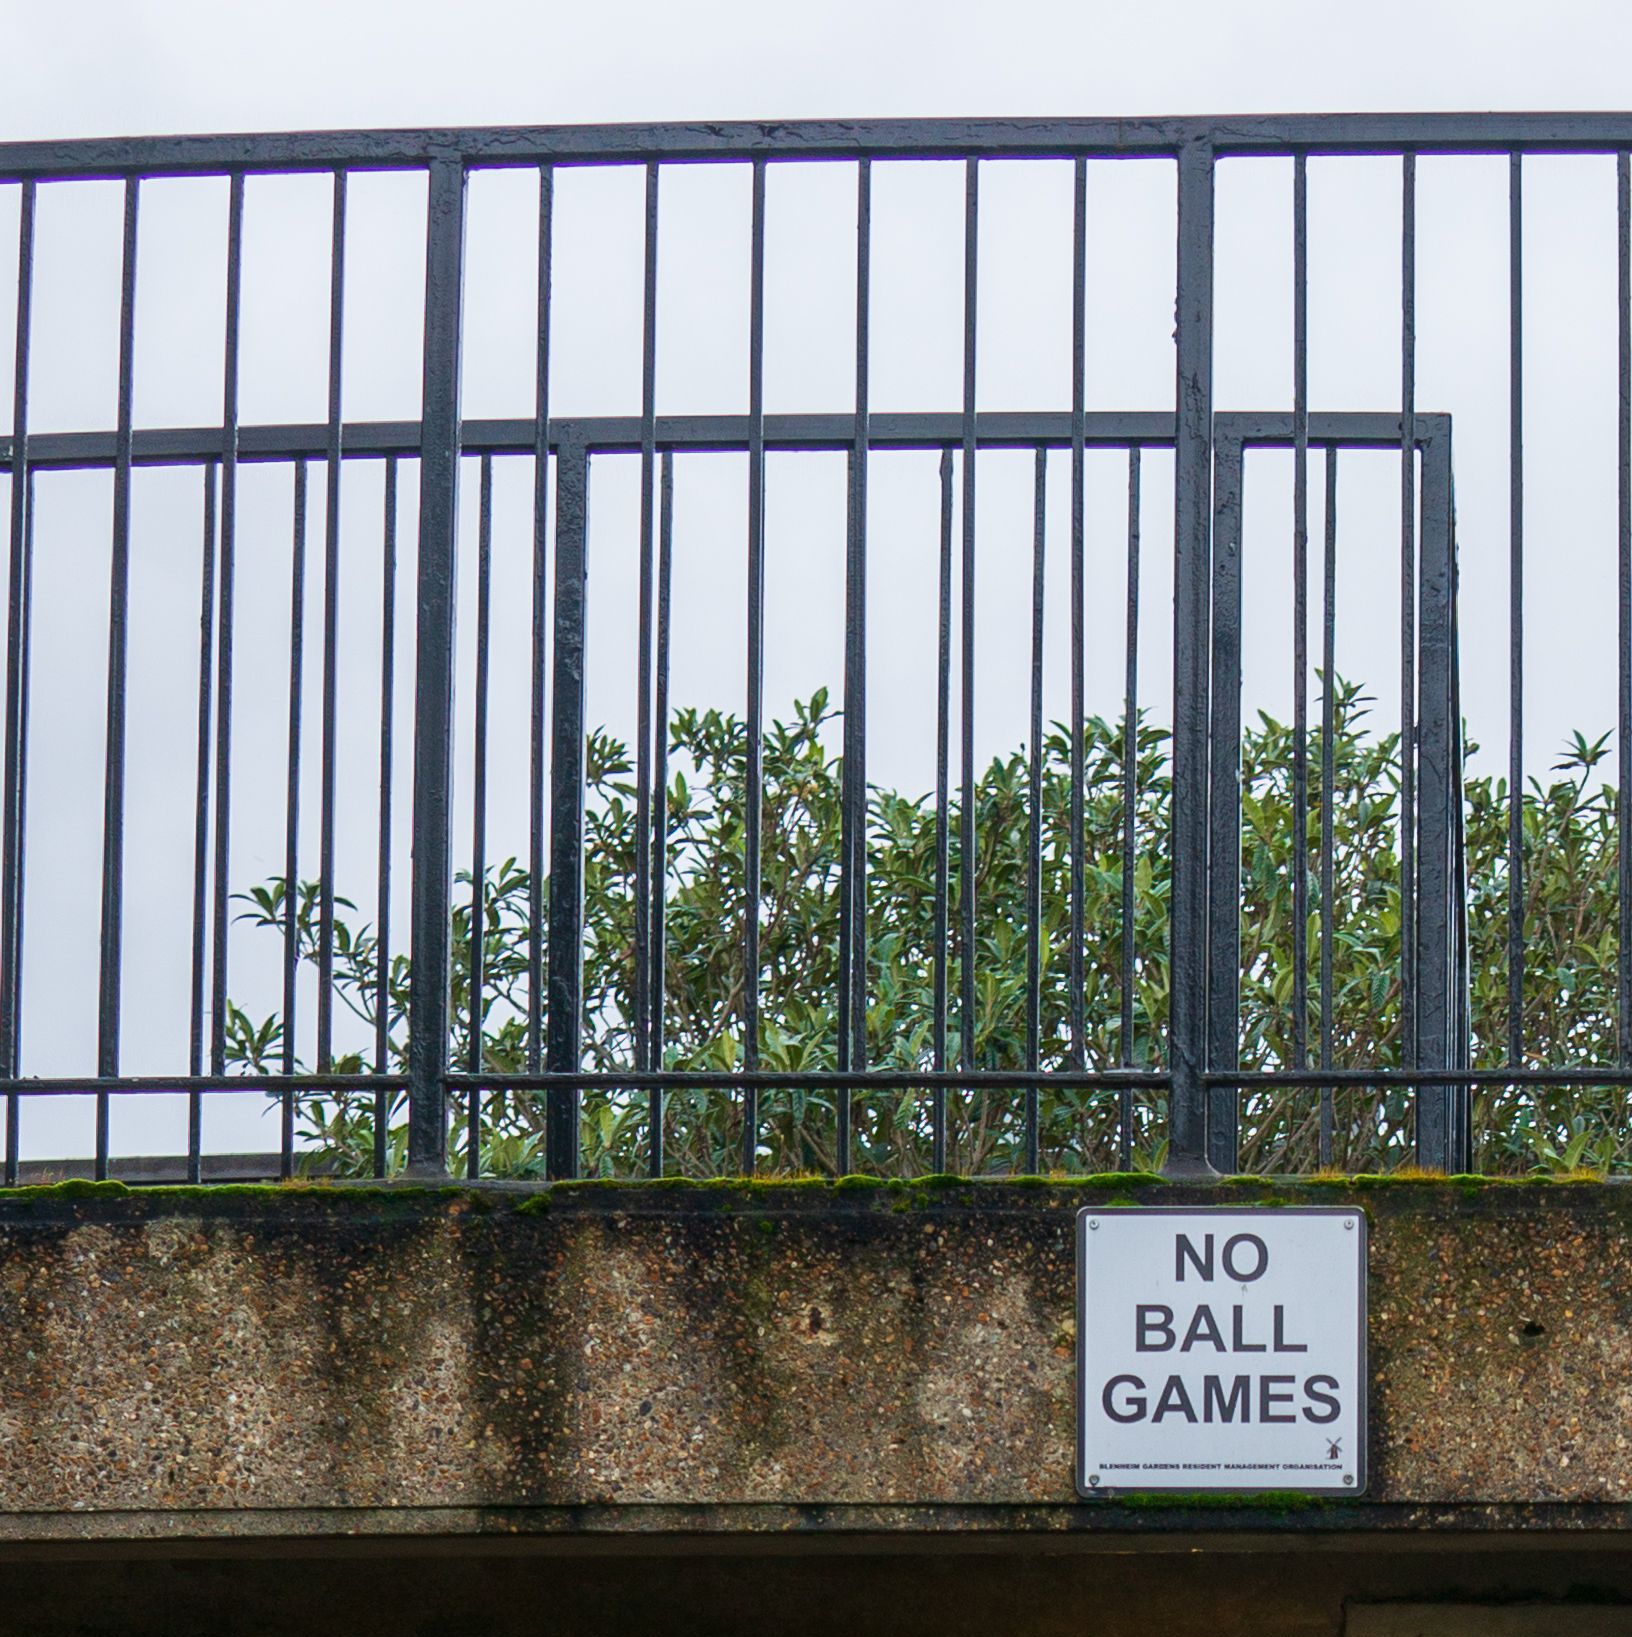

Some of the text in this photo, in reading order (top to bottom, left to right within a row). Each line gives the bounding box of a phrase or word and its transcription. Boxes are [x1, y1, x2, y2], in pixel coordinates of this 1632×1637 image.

[1174, 1233, 1269, 1283] NO
[1135, 1304, 1309, 1353] BALL
[1101, 1374, 1342, 1424] GAMES
